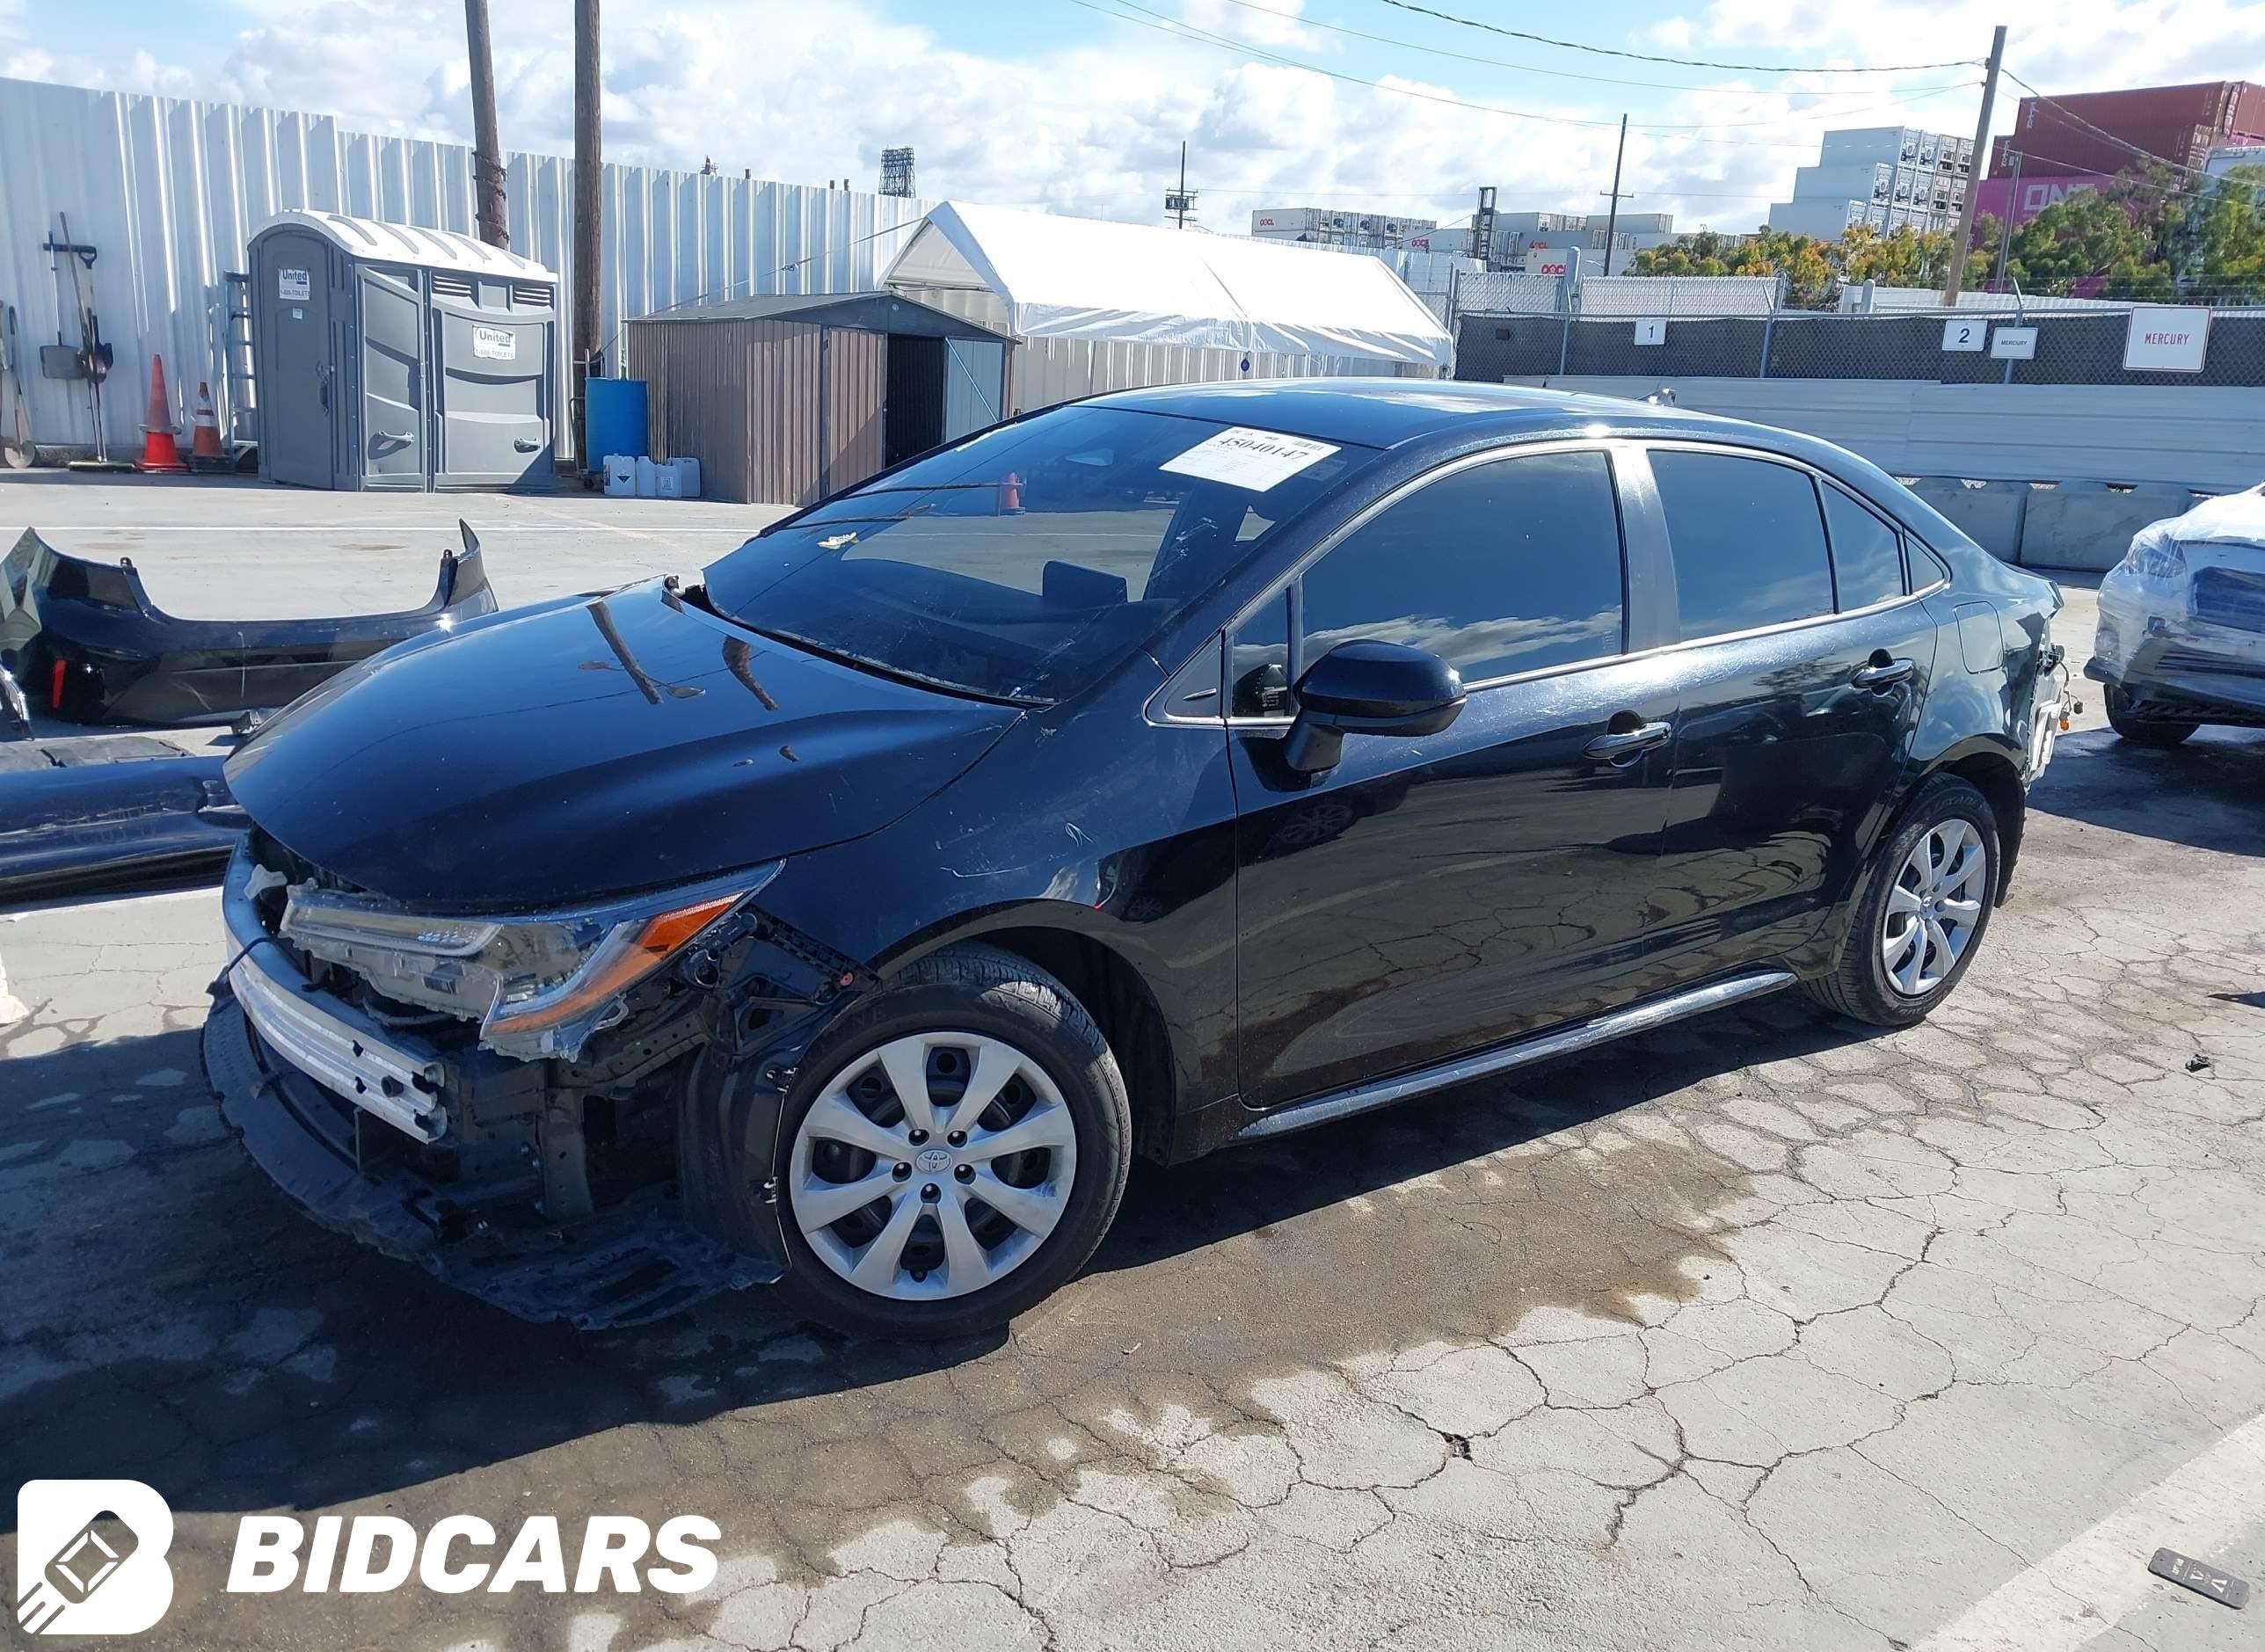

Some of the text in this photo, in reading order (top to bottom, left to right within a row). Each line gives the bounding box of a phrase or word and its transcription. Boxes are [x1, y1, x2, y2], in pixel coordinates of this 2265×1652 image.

[282, 269, 307, 280] United
[479, 330, 511, 343] United
[1648, 325, 1654, 338] 1
[1958, 328, 1970, 343] 2
[2145, 332, 2189, 346] MERCURY
[1219, 437, 1310, 460] 45040147
